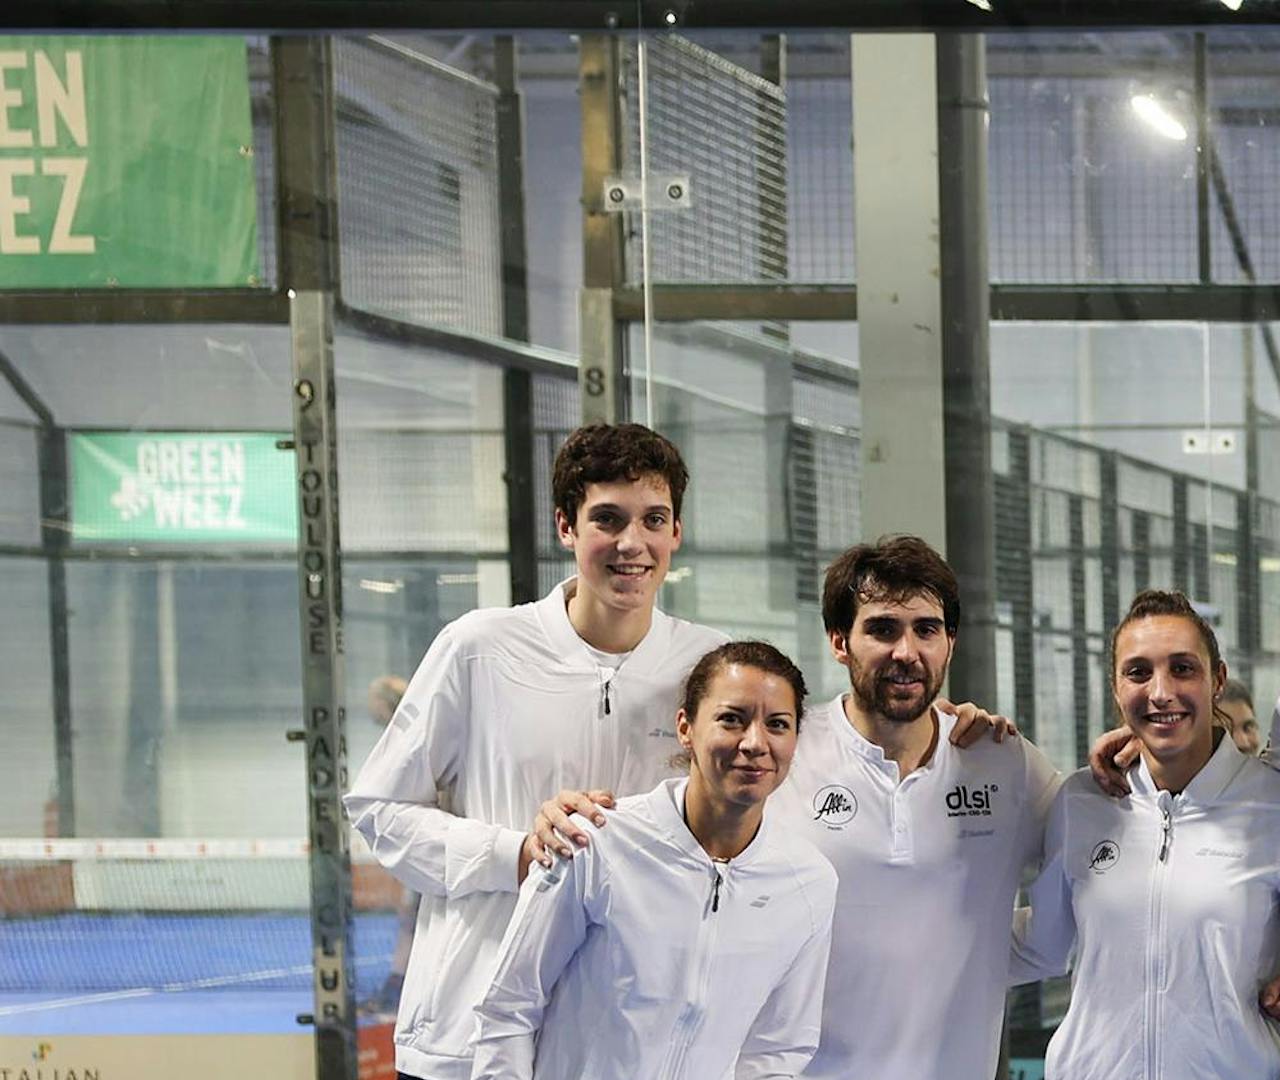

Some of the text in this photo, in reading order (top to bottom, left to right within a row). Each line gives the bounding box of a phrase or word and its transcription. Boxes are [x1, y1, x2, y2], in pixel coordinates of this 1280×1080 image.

[136, 440, 245, 482] GREEN
[153, 484, 247, 529] WEEZ
[946, 785, 990, 809] dlsi
